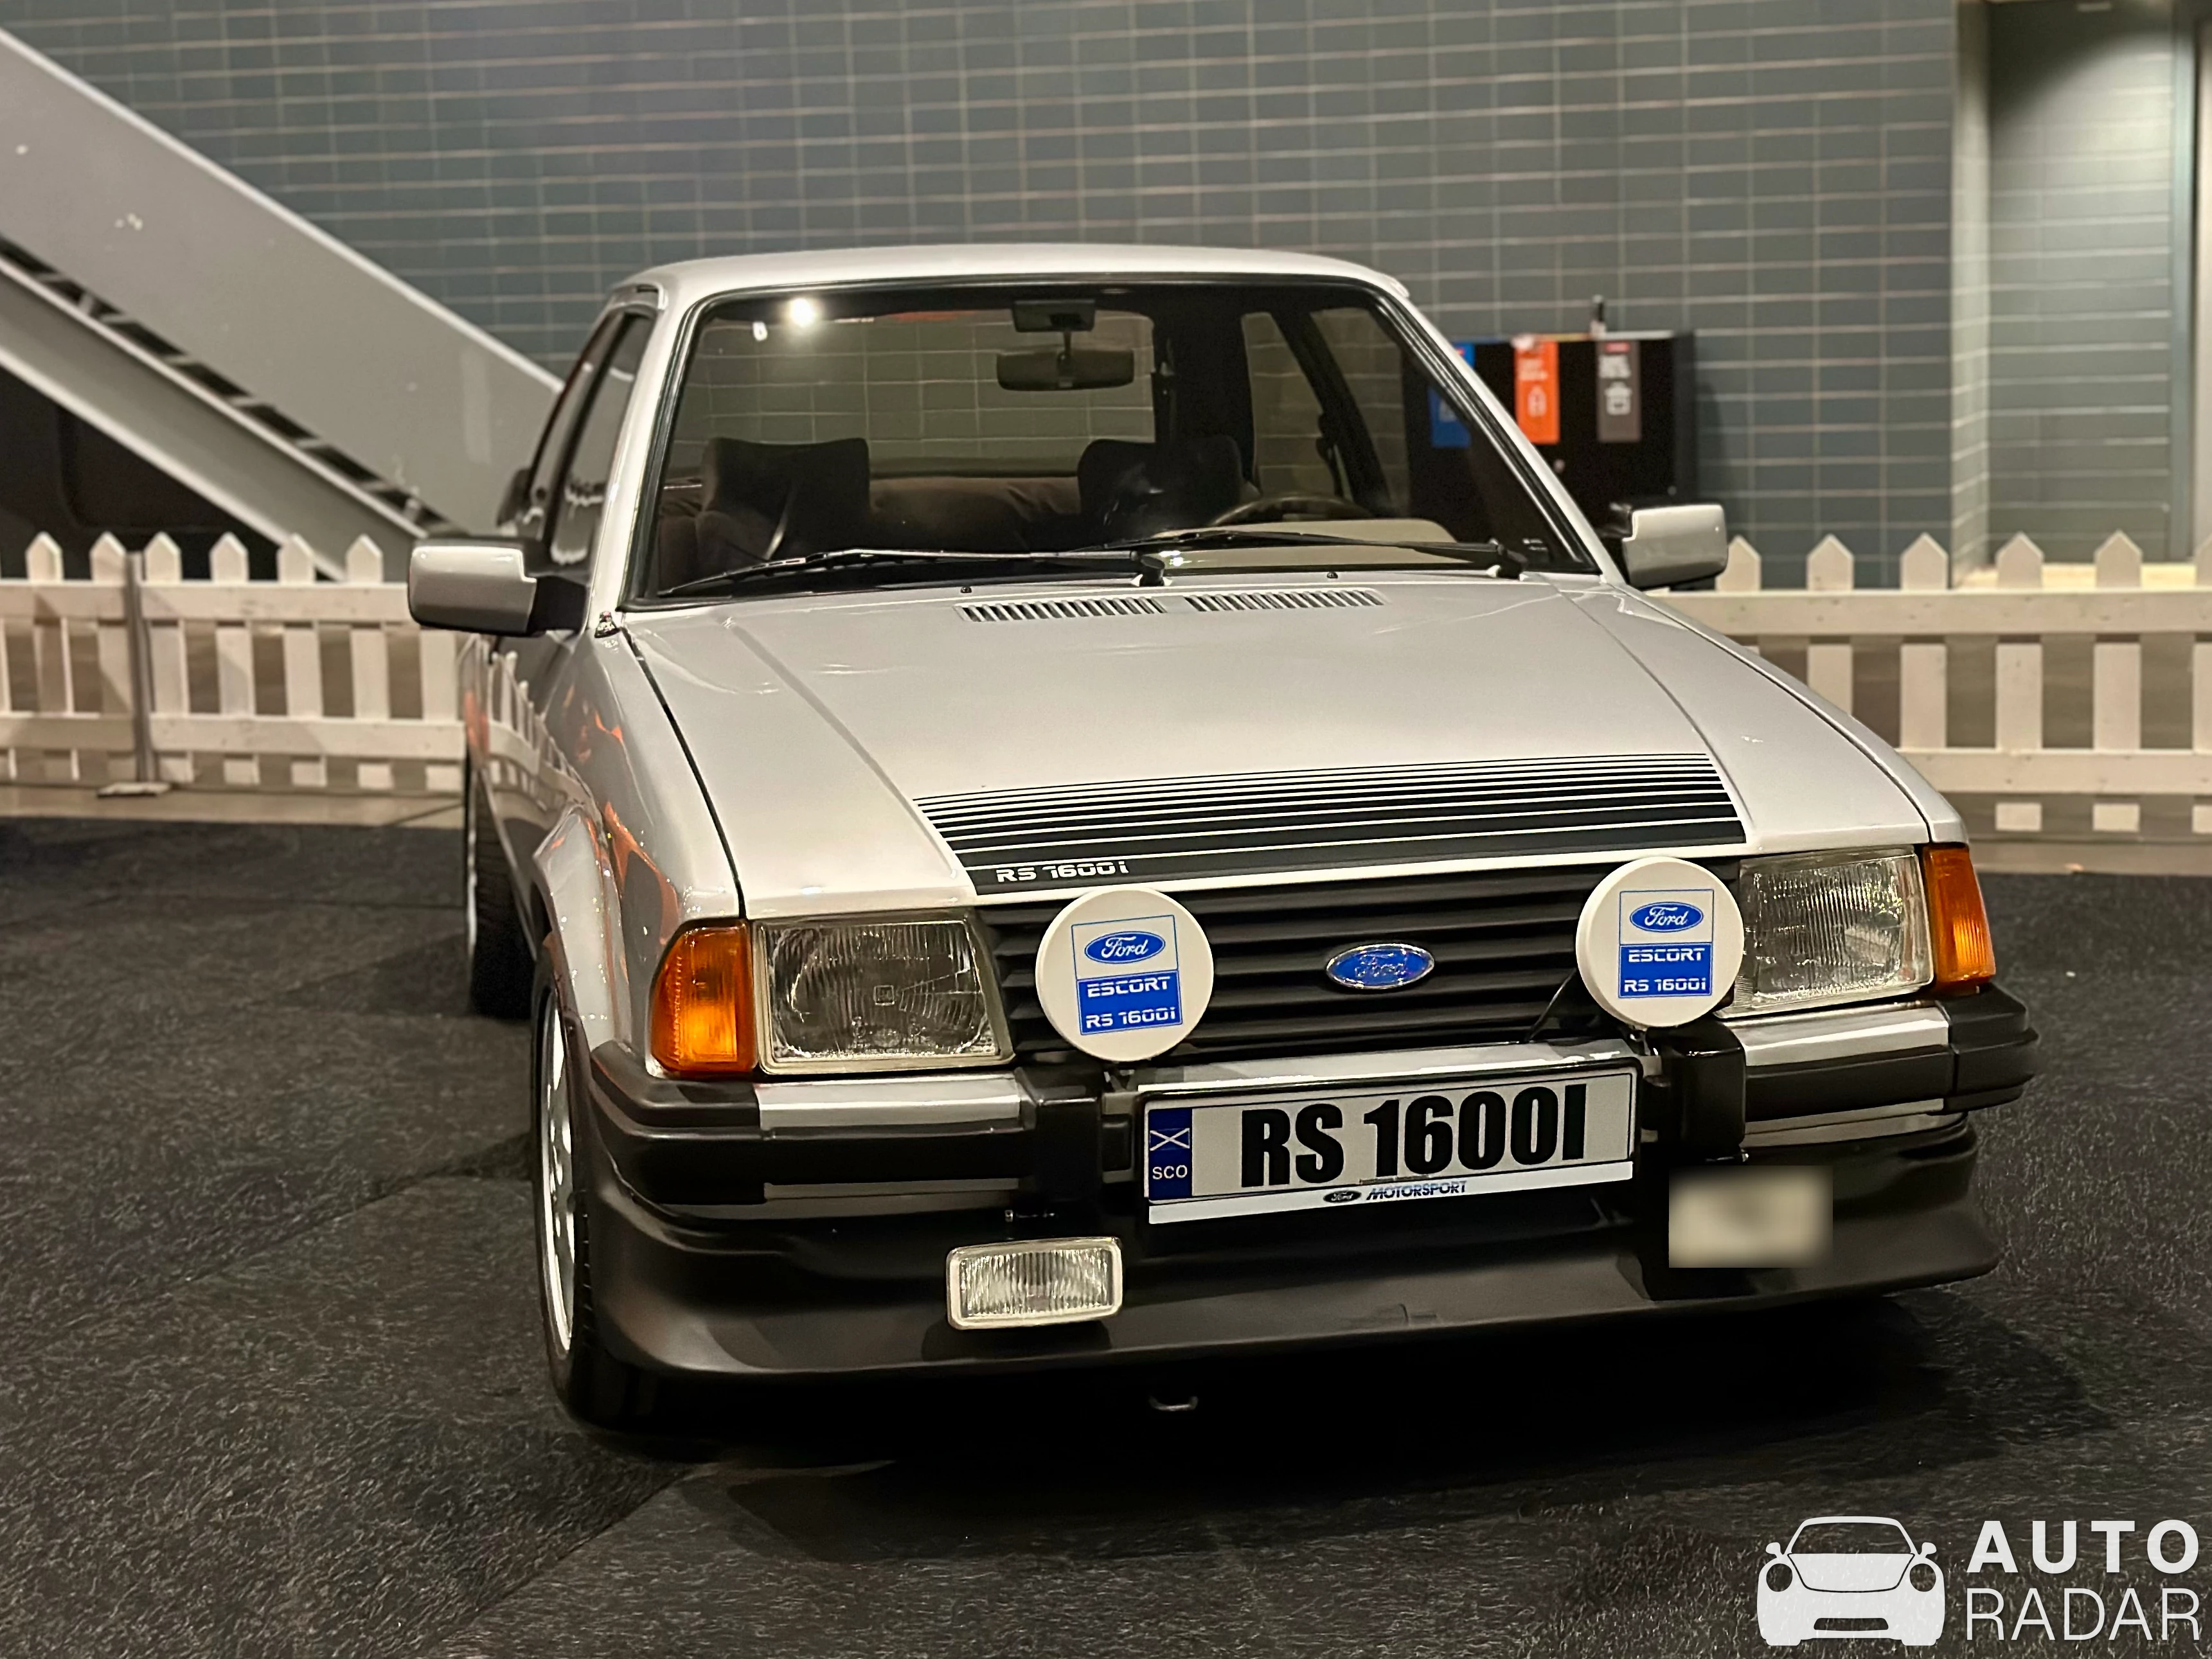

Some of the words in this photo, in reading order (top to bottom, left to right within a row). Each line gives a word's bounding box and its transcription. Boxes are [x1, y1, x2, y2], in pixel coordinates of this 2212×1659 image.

[996, 867, 1037, 882] RS
[1042, 861, 1129, 879] 1600i
[1644, 906, 1689, 926] Ford
[1101, 936, 1148, 958] Ford
[1628, 948, 1705, 963] ESCORT
[1087, 977, 1170, 998] ESCORT
[1624, 979, 1649, 992] RS
[1654, 977, 1706, 991] 1600i
[1086, 1013, 1113, 1028] RS
[1118, 1007, 1175, 1025] 1600i
[1242, 1103, 1343, 1187] RS
[1364, 1084, 1587, 1178] 1600I
[1152, 1165, 1188, 1180] SCO
[1366, 1180, 1467, 1200] MOTORSPORT
